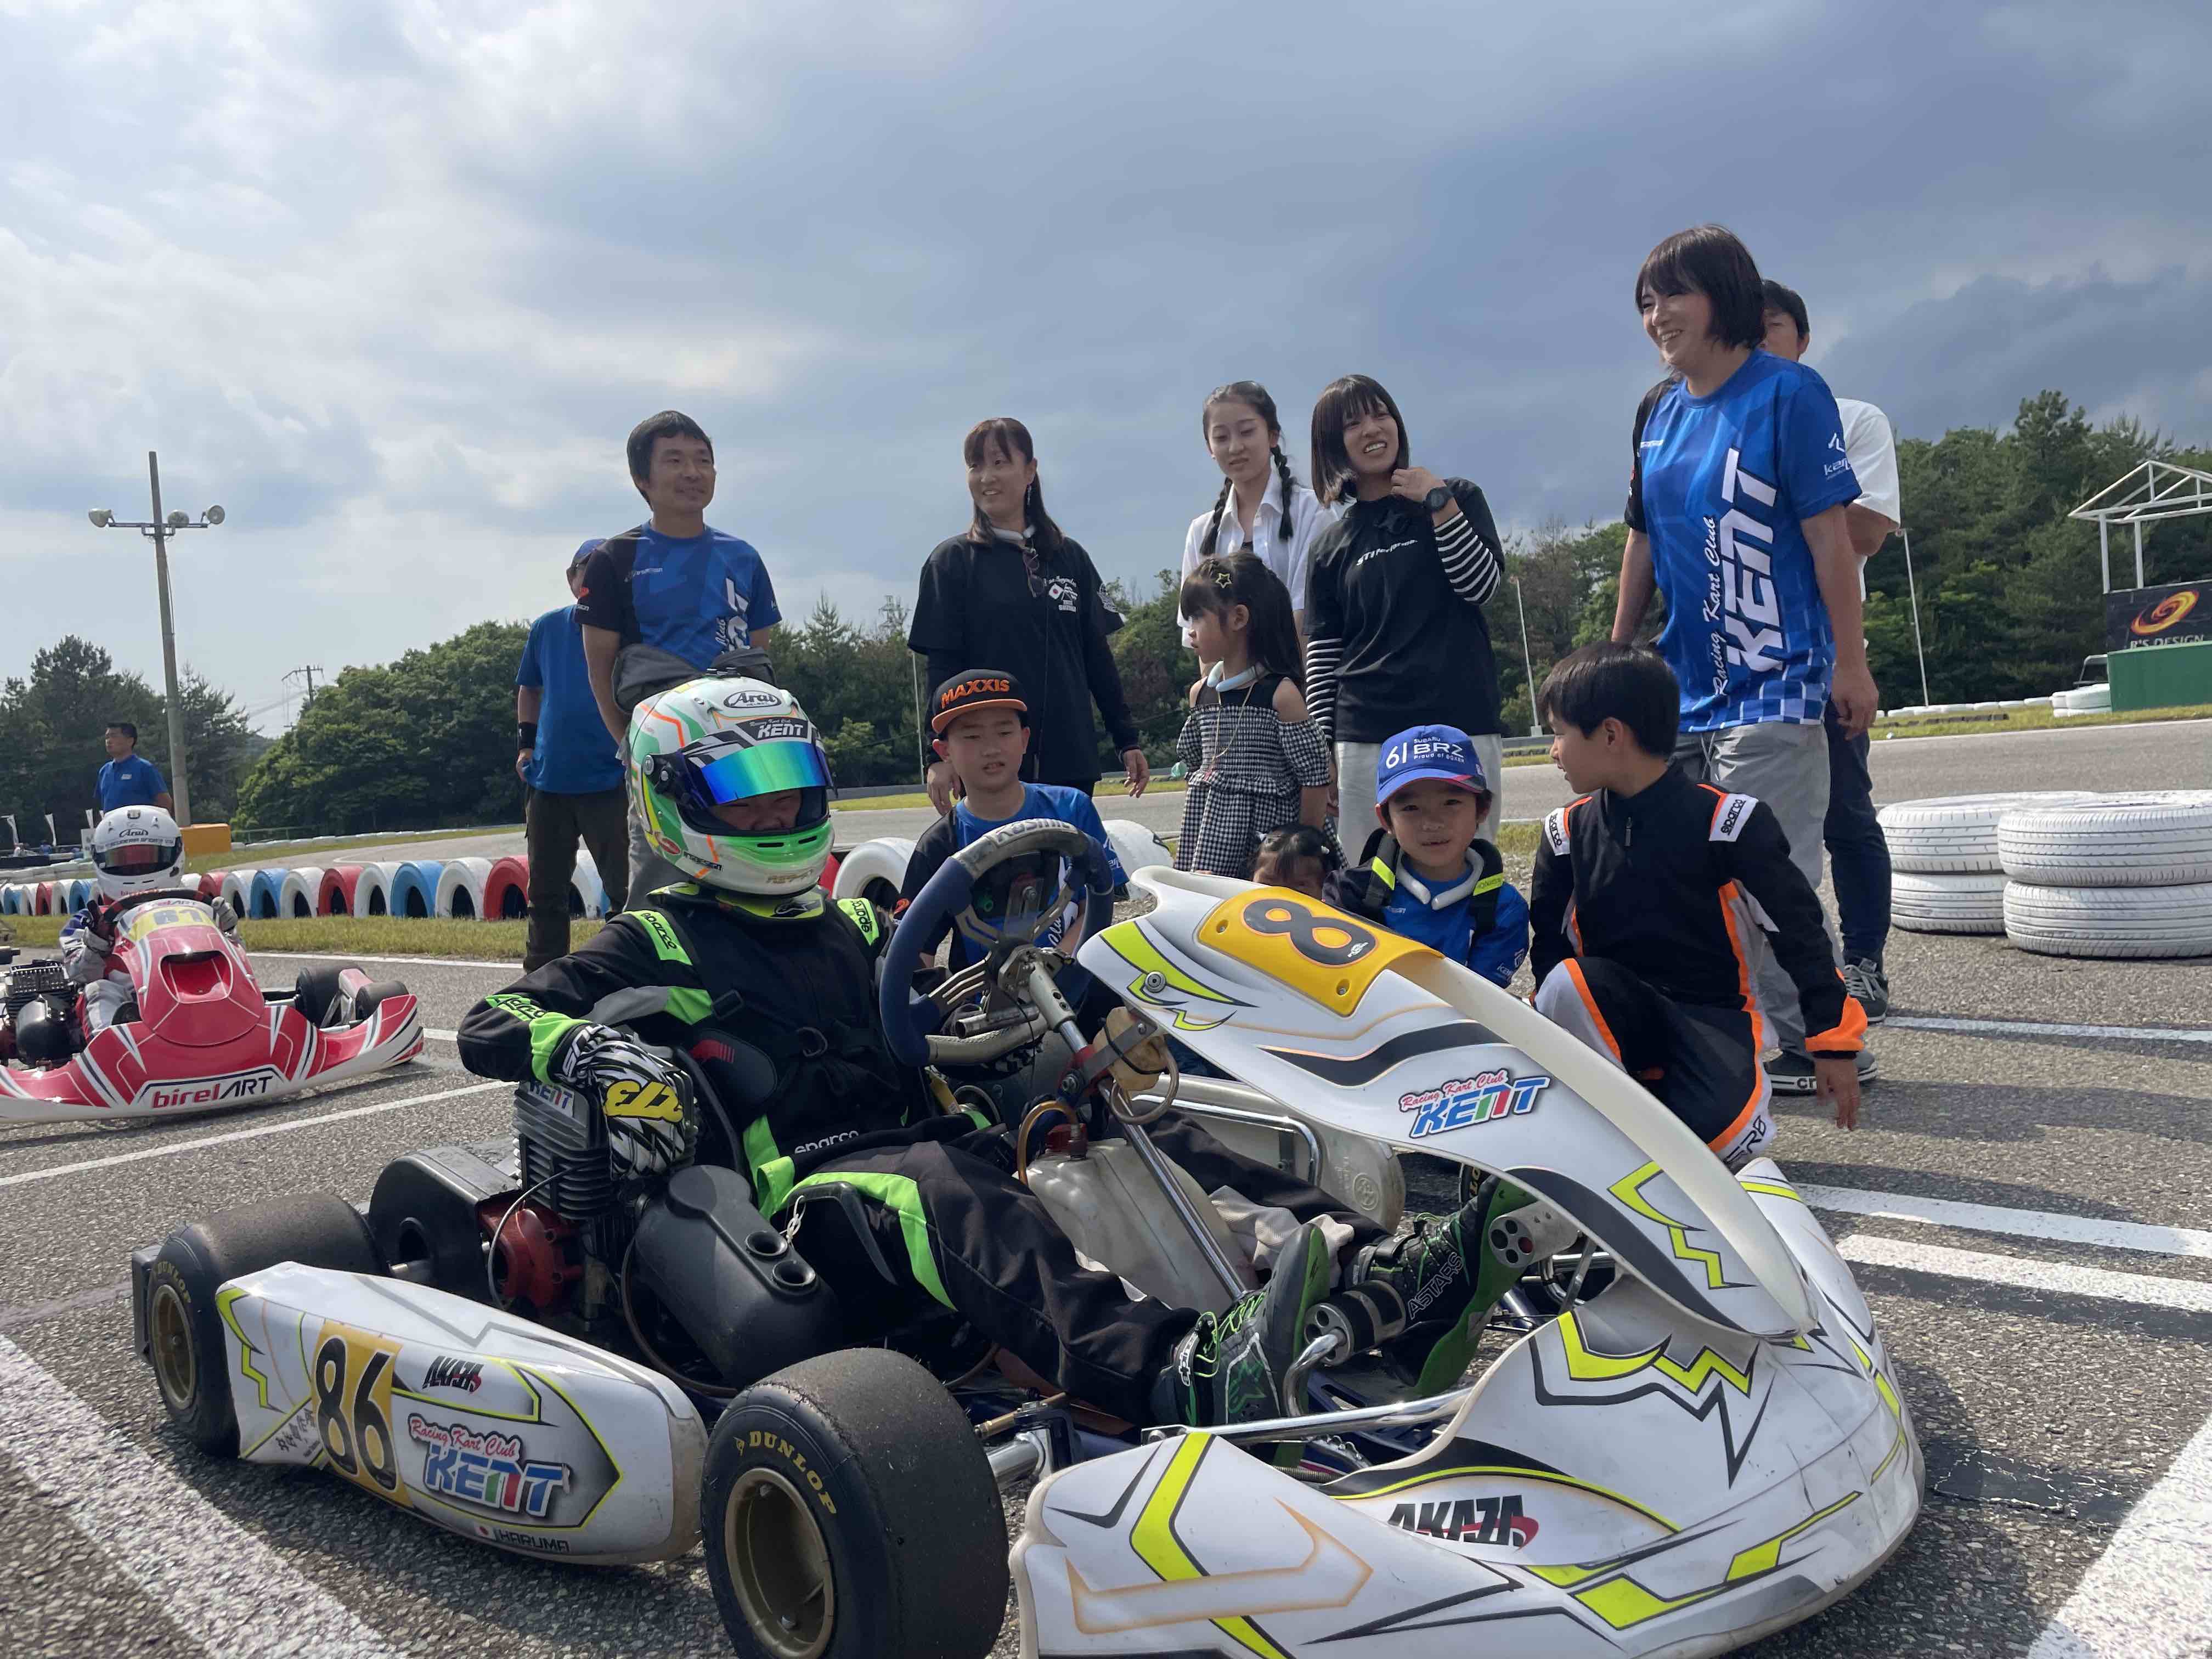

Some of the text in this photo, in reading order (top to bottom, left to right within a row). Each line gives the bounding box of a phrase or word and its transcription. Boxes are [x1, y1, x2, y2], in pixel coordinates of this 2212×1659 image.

[1719, 447, 1783, 672] KENT
[1702, 516, 1730, 696] Racing Kart Club
[730, 692, 776, 707] Arai
[941, 679, 1010, 709] MAXXIS
[758, 723, 804, 738] KENT
[1414, 742, 1464, 758] BRZ
[1386, 742, 1407, 769] 61
[1720, 799, 1746, 836] sparco
[1402, 1071, 1504, 1107] Racing Kart Club
[1412, 1078, 1547, 1135] KENT
[157, 1261, 191, 1303] DUNLOP
[1408, 1251, 1464, 1321] ASTARS
[313, 1335, 398, 1492] 86
[410, 1419, 516, 1458] Racing Kart Club
[426, 1443, 566, 1513] KENT
[748, 1430, 838, 1515] DUNLOP
[1387, 1494, 1525, 1547] AKAZA
